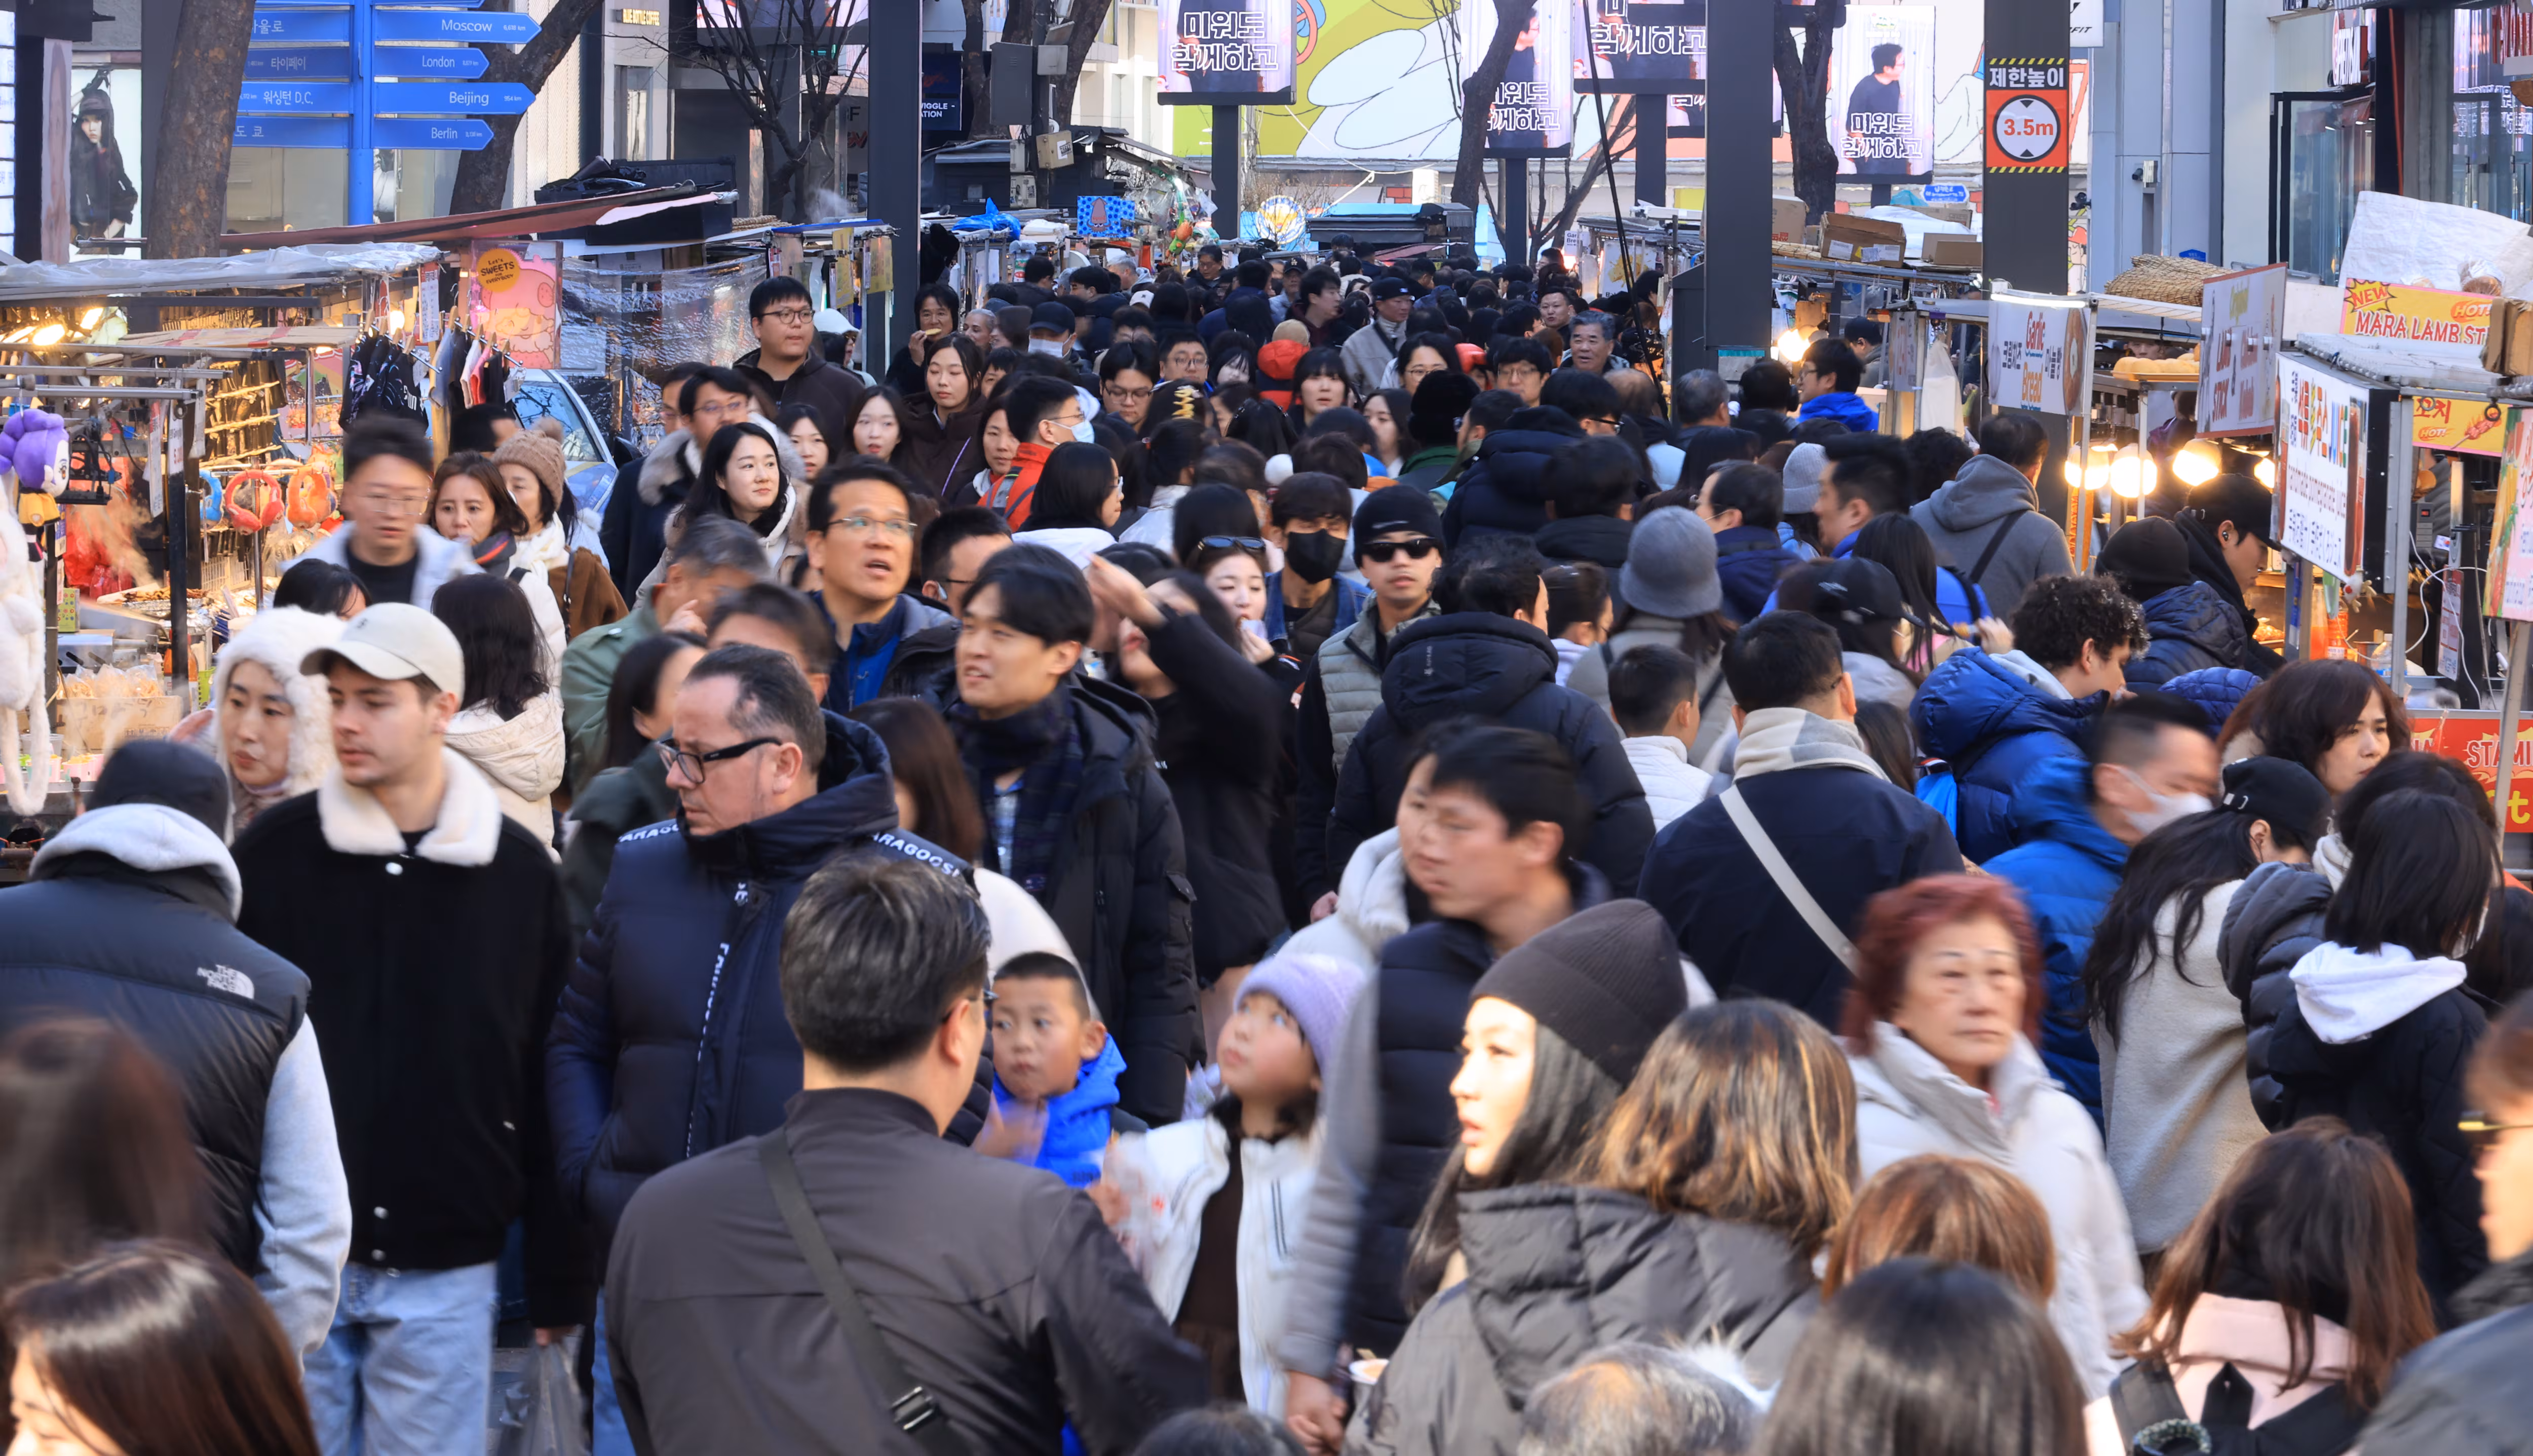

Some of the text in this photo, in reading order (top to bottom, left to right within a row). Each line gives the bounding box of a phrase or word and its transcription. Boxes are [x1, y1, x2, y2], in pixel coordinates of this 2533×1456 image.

[441, 19, 492, 32] Moscow
[1184, 11, 1265, 39] 미워도
[271, 56, 306, 71] 타이페이
[422, 56, 455, 68] London
[1170, 43, 1279, 71] 함께하고
[1989, 67, 2064, 88] 제한높이
[263, 90, 291, 105] 워싱턴
[295, 91, 314, 105] D.C.
[449, 91, 489, 106] Beijing
[1850, 112, 1913, 135] 미워도
[2004, 118, 2053, 136] 3.5m
[431, 128, 458, 139] Berlin
[1839, 137, 1924, 159] 함께하고
[481, 261, 515, 277] SWEETS
[486, 274, 514, 284] EVERYBODY
[2352, 286, 2388, 306] NEW
[2453, 304, 2492, 318] HOT!
[2026, 311, 2045, 351] Garlic
[2356, 310, 2406, 339] MARA
[2411, 317, 2459, 343] LAMB
[2003, 341, 2022, 370] 크림치즈
[2045, 346, 2062, 380] 마늘빵
[2022, 361, 2043, 403] Bread
[2420, 428, 2447, 438] HOT!
